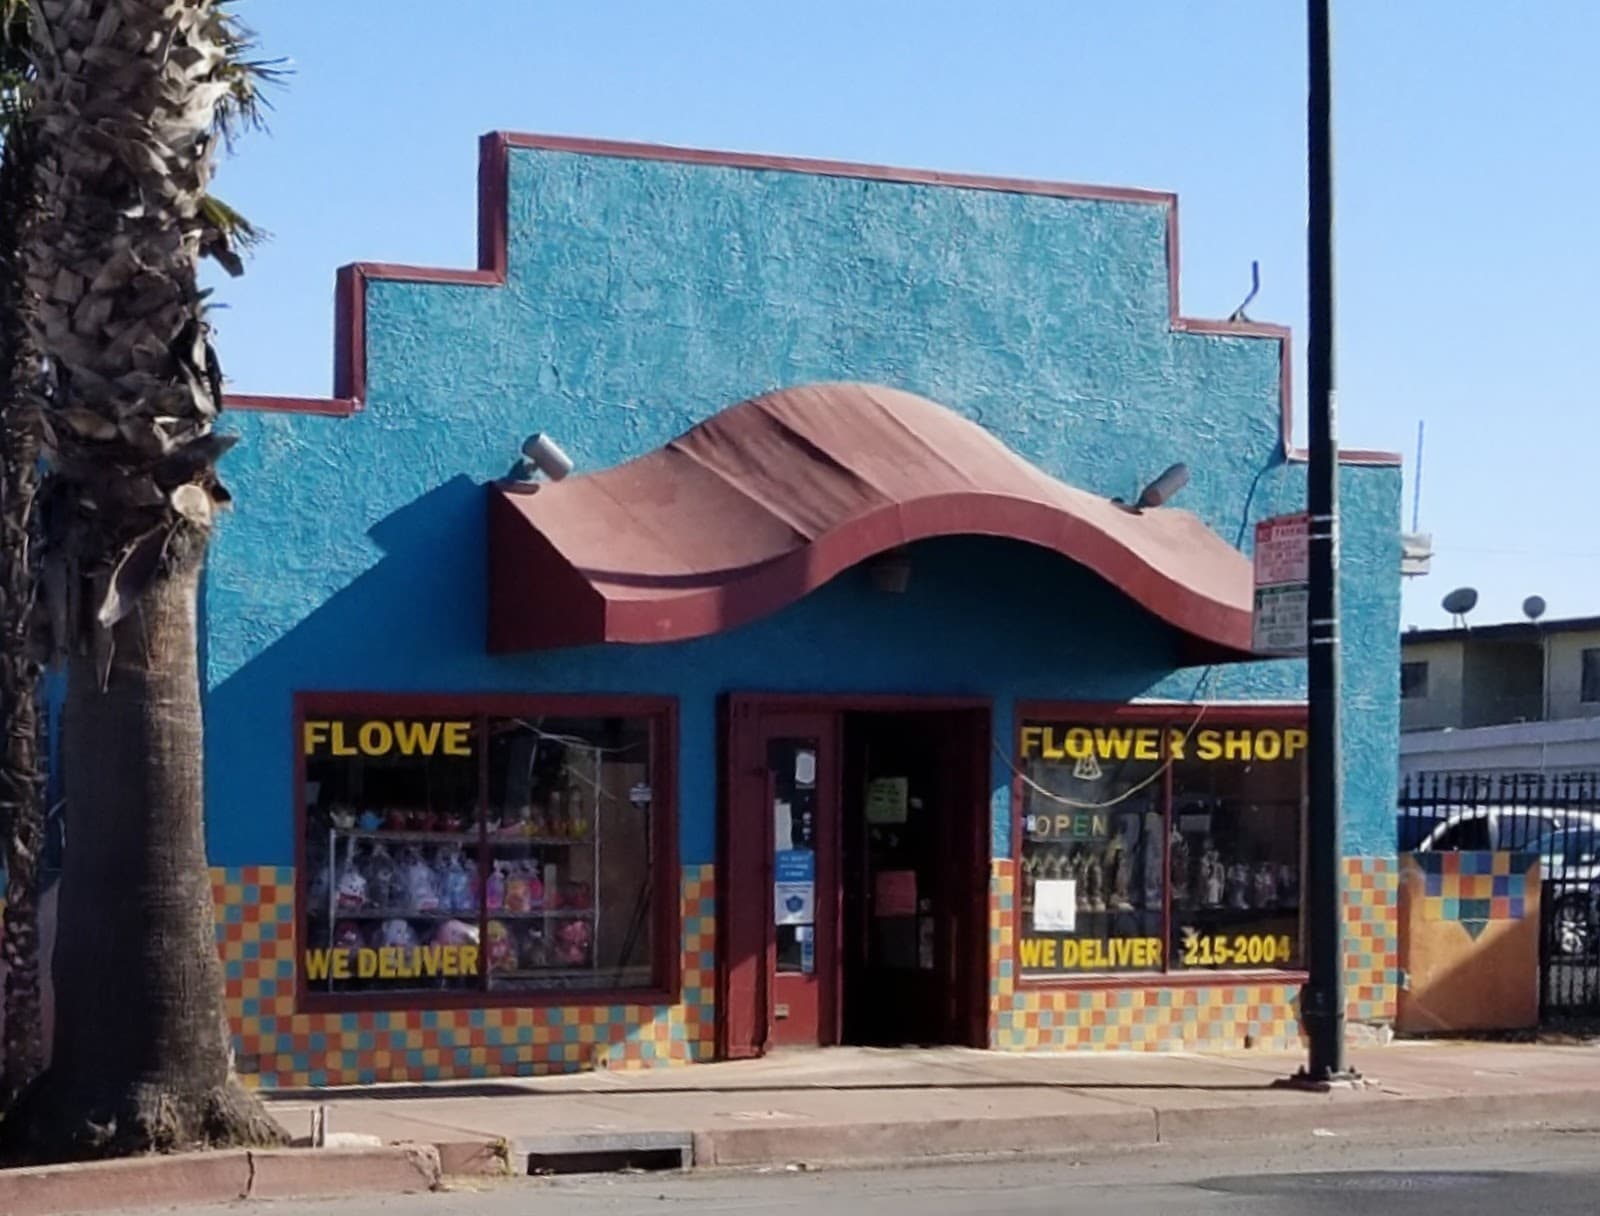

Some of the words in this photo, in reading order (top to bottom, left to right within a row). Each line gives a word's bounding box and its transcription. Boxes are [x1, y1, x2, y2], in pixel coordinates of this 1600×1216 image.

[304, 721, 471, 755] FLOWE
[1020, 727, 1184, 759] FLOWER
[1197, 729, 1308, 760] SHOP
[1035, 815, 1106, 837] OPEN
[306, 948, 353, 980] WE
[358, 945, 479, 978] DELIVER
[1020, 939, 1056, 967] WE
[1063, 937, 1163, 969] DELIVER
[1184, 935, 1291, 964] 215-2004
